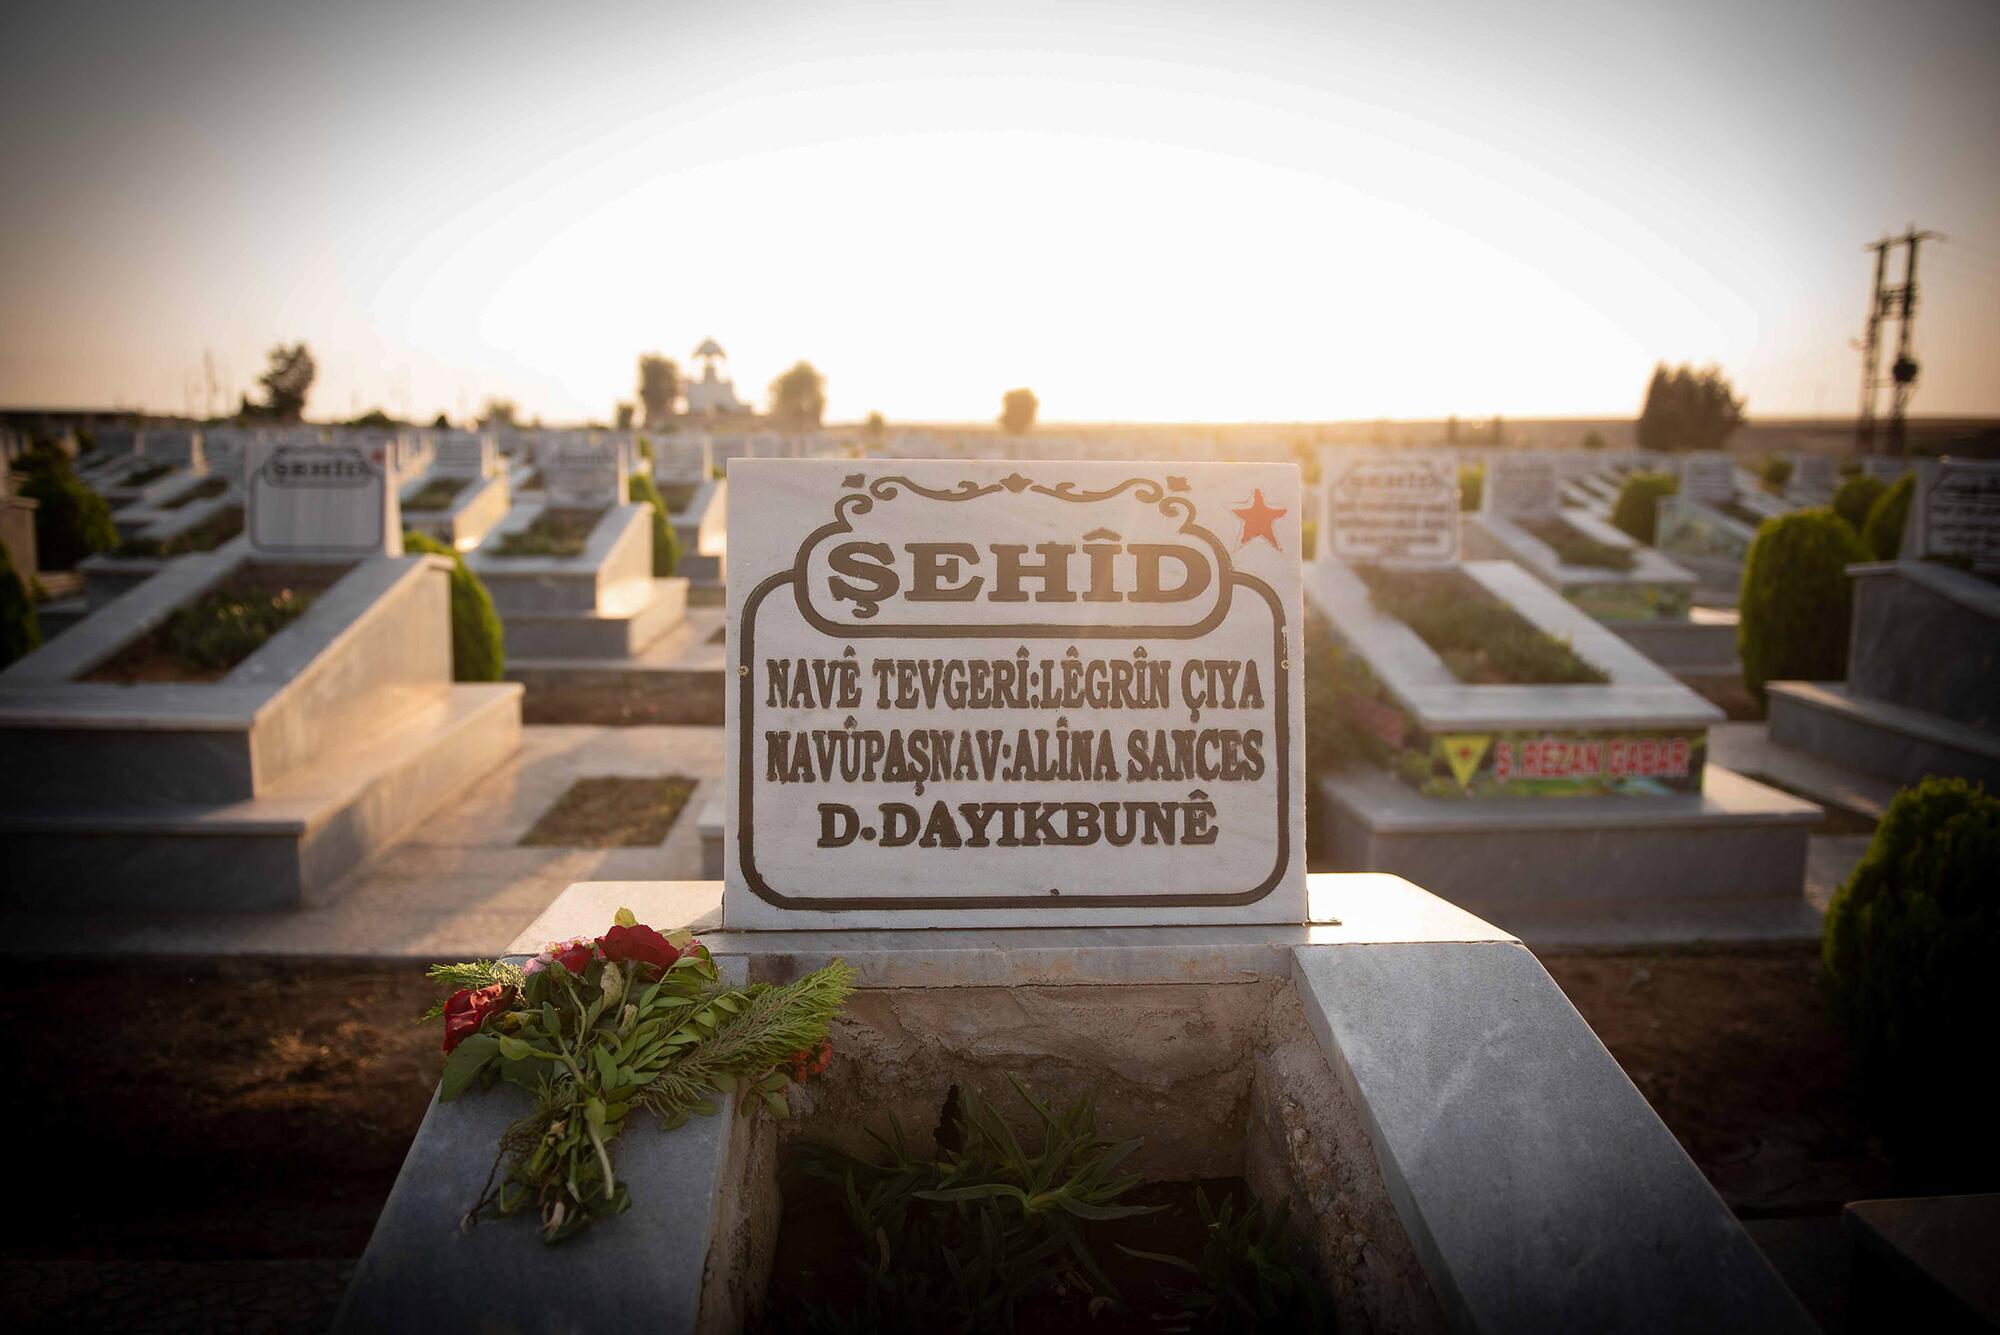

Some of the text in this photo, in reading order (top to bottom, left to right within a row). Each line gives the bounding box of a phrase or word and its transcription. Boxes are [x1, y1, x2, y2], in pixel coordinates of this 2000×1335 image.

[828, 529, 1211, 618] ŞEHÎD
[766, 645, 862, 709] NAVÊ
[1181, 659, 1265, 723] ÇIYA
[1127, 728, 1265, 782] SANCES
